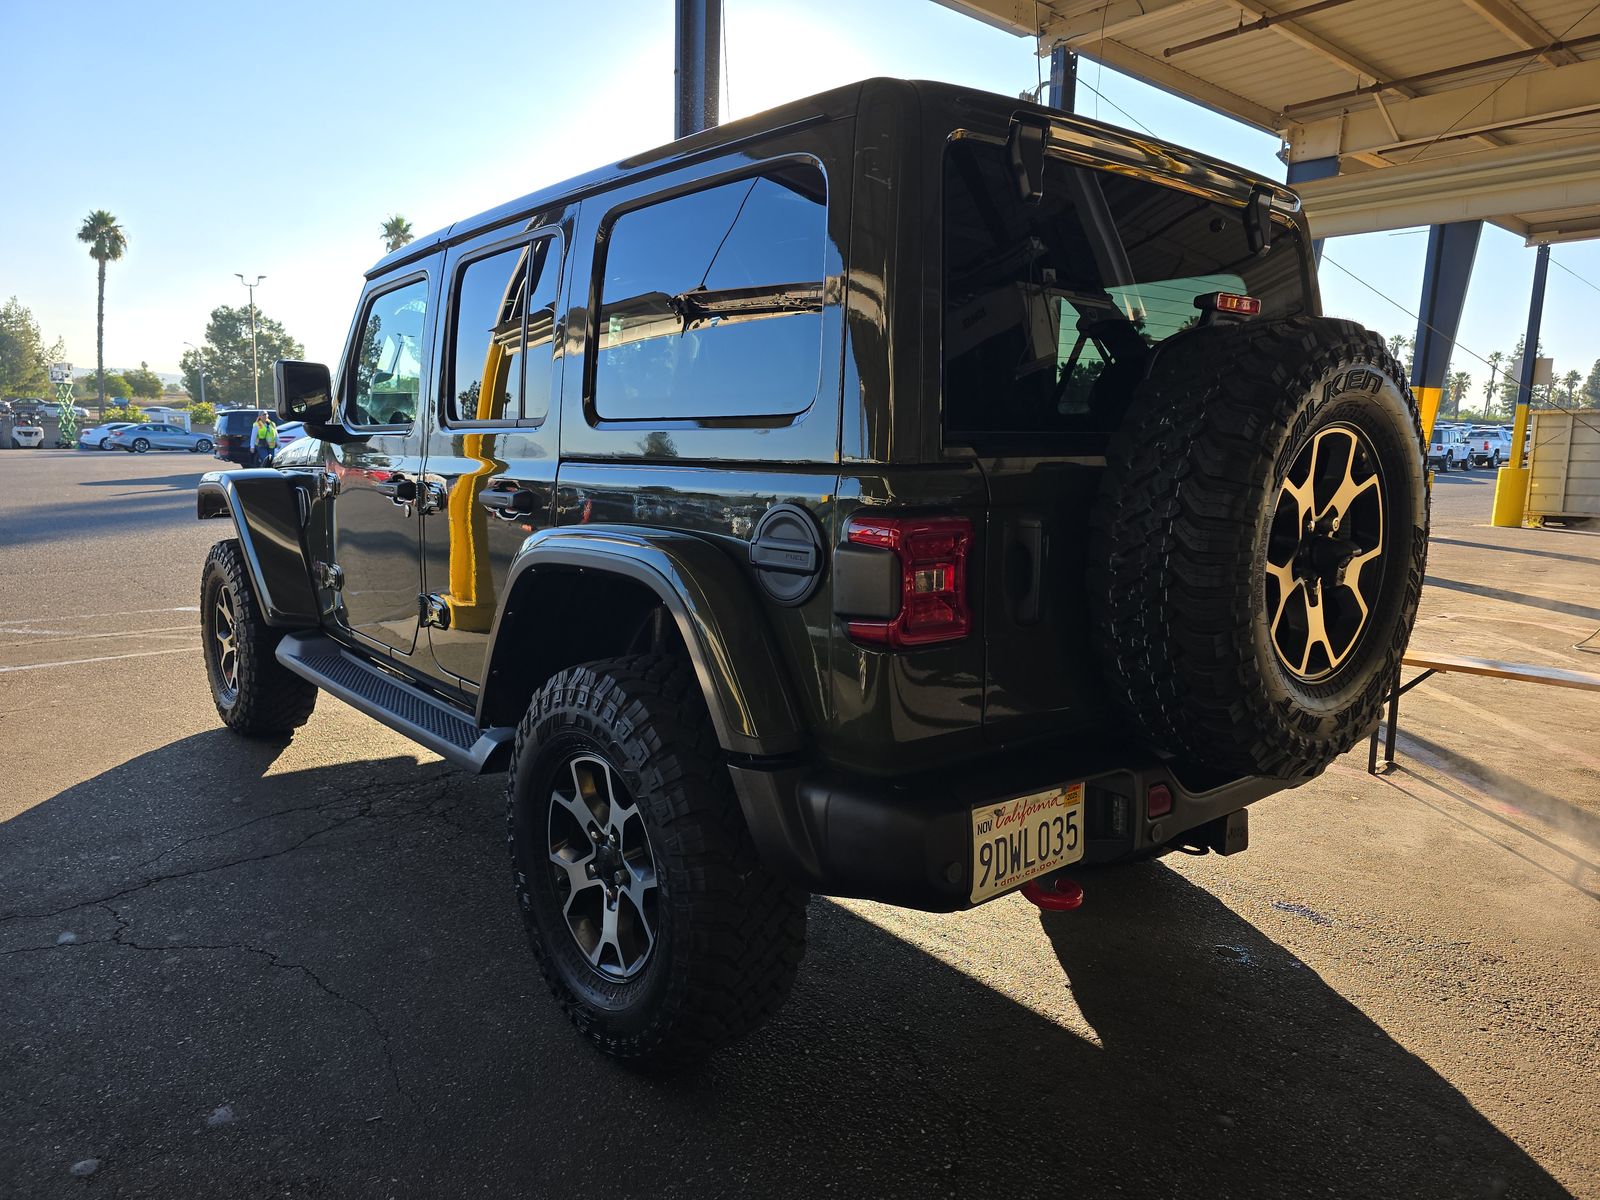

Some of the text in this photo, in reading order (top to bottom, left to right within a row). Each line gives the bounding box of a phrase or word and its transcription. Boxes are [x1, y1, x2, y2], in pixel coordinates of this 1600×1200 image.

[1273, 368, 1383, 492] FALKEN
[785, 552, 805, 562] FUEL
[995, 792, 1064, 829] California
[977, 819, 993, 836] NOV
[979, 810, 1077, 888] 9DWL035
[1000, 858, 1058, 887] dmv.ca.gov
